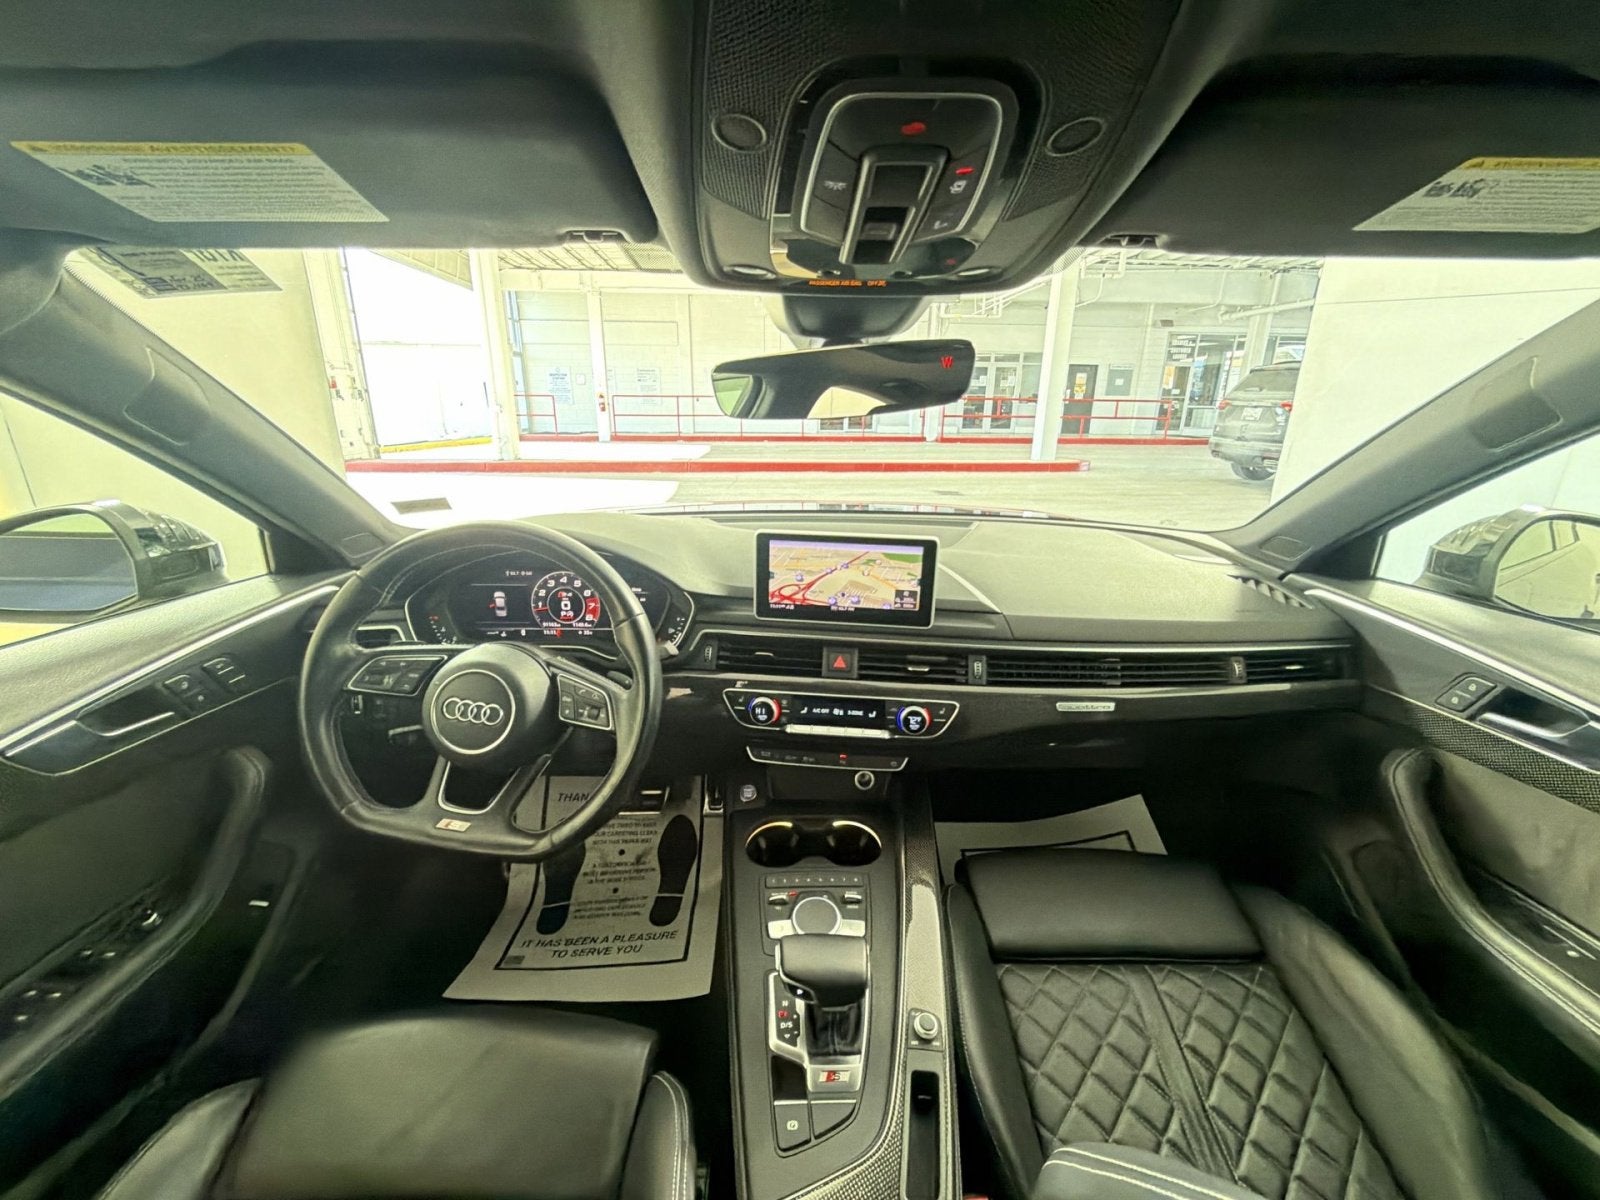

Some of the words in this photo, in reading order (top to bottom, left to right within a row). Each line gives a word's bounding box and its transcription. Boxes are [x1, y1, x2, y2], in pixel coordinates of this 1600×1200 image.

[940, 355, 953, 368] W
[538, 589, 546, 597] 2
[561, 601, 571, 610] 0
[558, 792, 590, 802] THAN
[521, 940, 532, 948] IT
[535, 938, 561, 948] HAS
[564, 936, 600, 947] BEEN
[600, 935, 610, 944] A
[612, 930, 679, 944] PLEASURE
[551, 949, 568, 958] TO
[570, 946, 613, 957] SERVE
[616, 944, 643, 954] YOU
